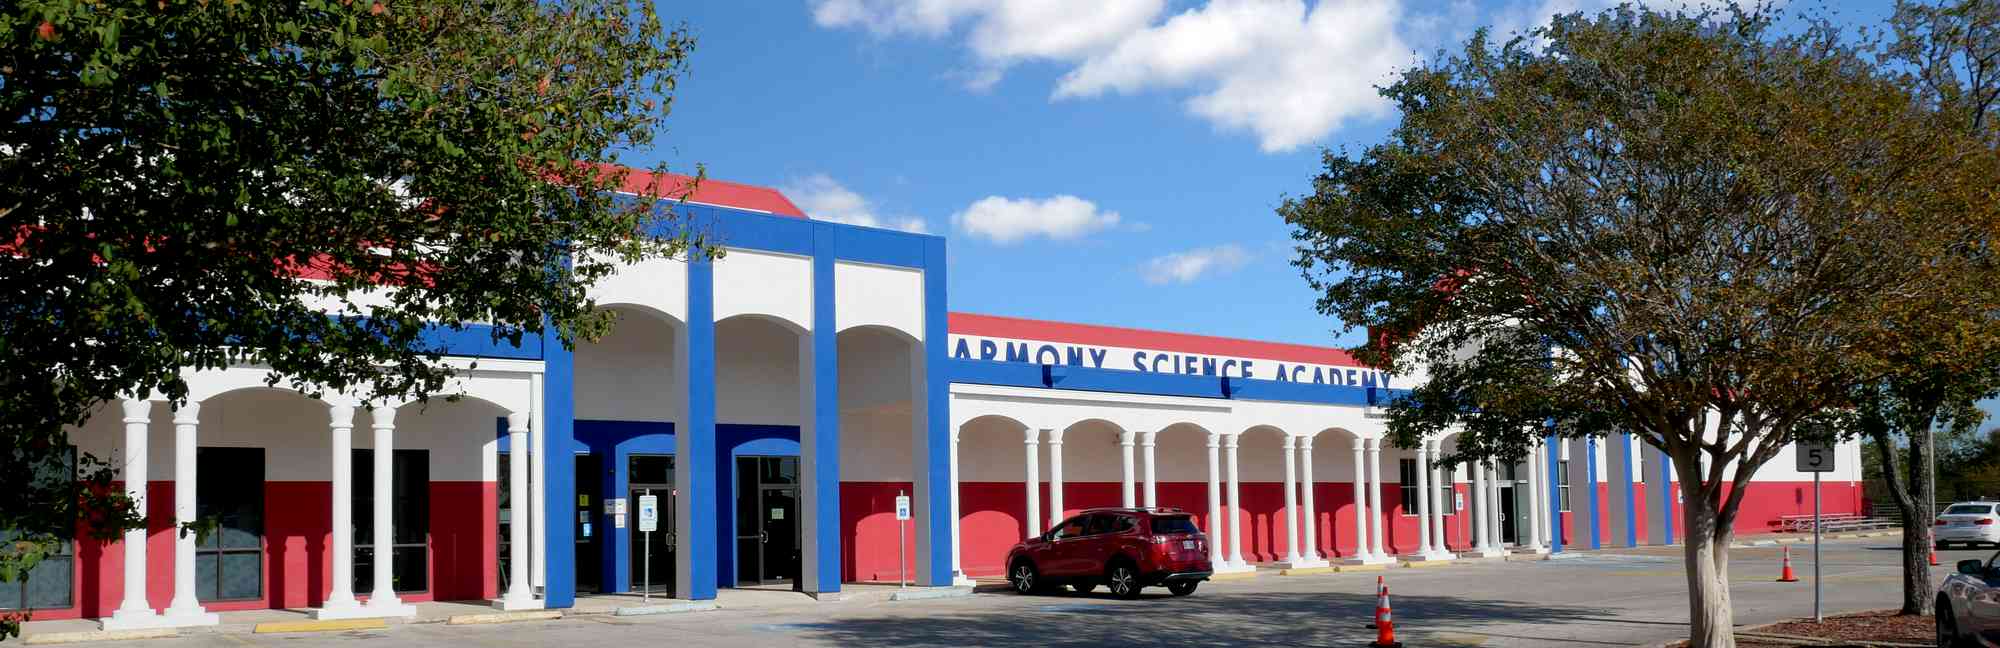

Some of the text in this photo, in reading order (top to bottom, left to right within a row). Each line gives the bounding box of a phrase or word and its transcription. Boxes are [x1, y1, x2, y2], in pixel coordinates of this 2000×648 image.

[954, 338, 1391, 388] ARMONY SCIENCE ACADEMY
[1809, 449, 1822, 466] 5
